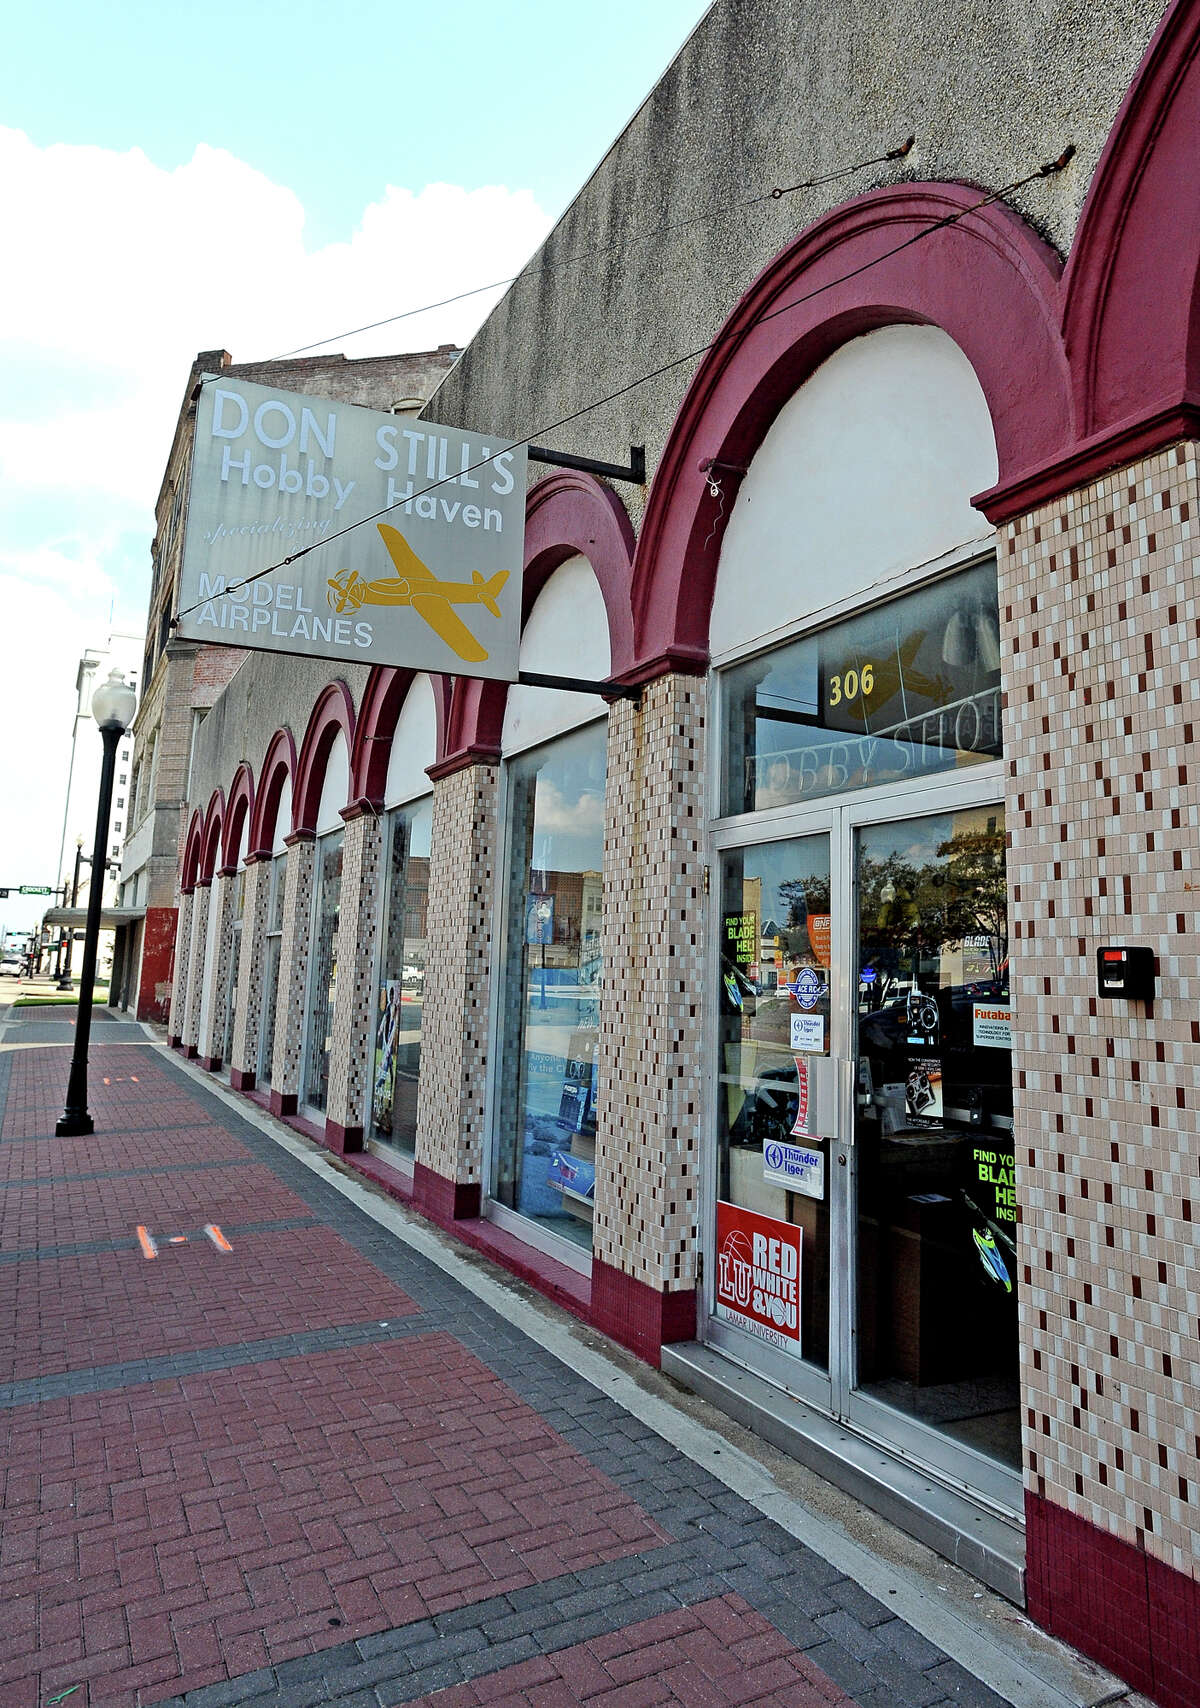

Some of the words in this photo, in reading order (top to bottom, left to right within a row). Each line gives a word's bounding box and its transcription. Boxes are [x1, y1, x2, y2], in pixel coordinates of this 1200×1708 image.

[211, 389, 336, 459] DON
[374, 424, 515, 496] STILL'S
[221, 446, 355, 511] Hobby
[387, 477, 502, 532] Haven
[198, 572, 313, 614] MODEL
[196, 601, 375, 649] AIRPLANES
[829, 664, 874, 706] 306
[728, 926, 755, 939] BLADE
[964, 935, 991, 947] BLADE
[736, 940, 755, 952] HELI
[975, 1008, 1011, 1021] Futaba
[781, 1145, 819, 1166] Thunder
[973, 1148, 997, 1163] FIND
[999, 1153, 1015, 1167] YO
[783, 1160, 805, 1176] Tiger
[978, 1163, 1016, 1187] BLAD
[995, 1186, 1016, 1207] HE
[995, 1206, 1016, 1222] INSI
[752, 1231, 798, 1280] RED
[719, 1253, 752, 1307] LU
[752, 1265, 797, 1303] WHITE
[726, 1308, 747, 1328] LAMAR
[749, 1322, 788, 1349] UNIVERSITY
